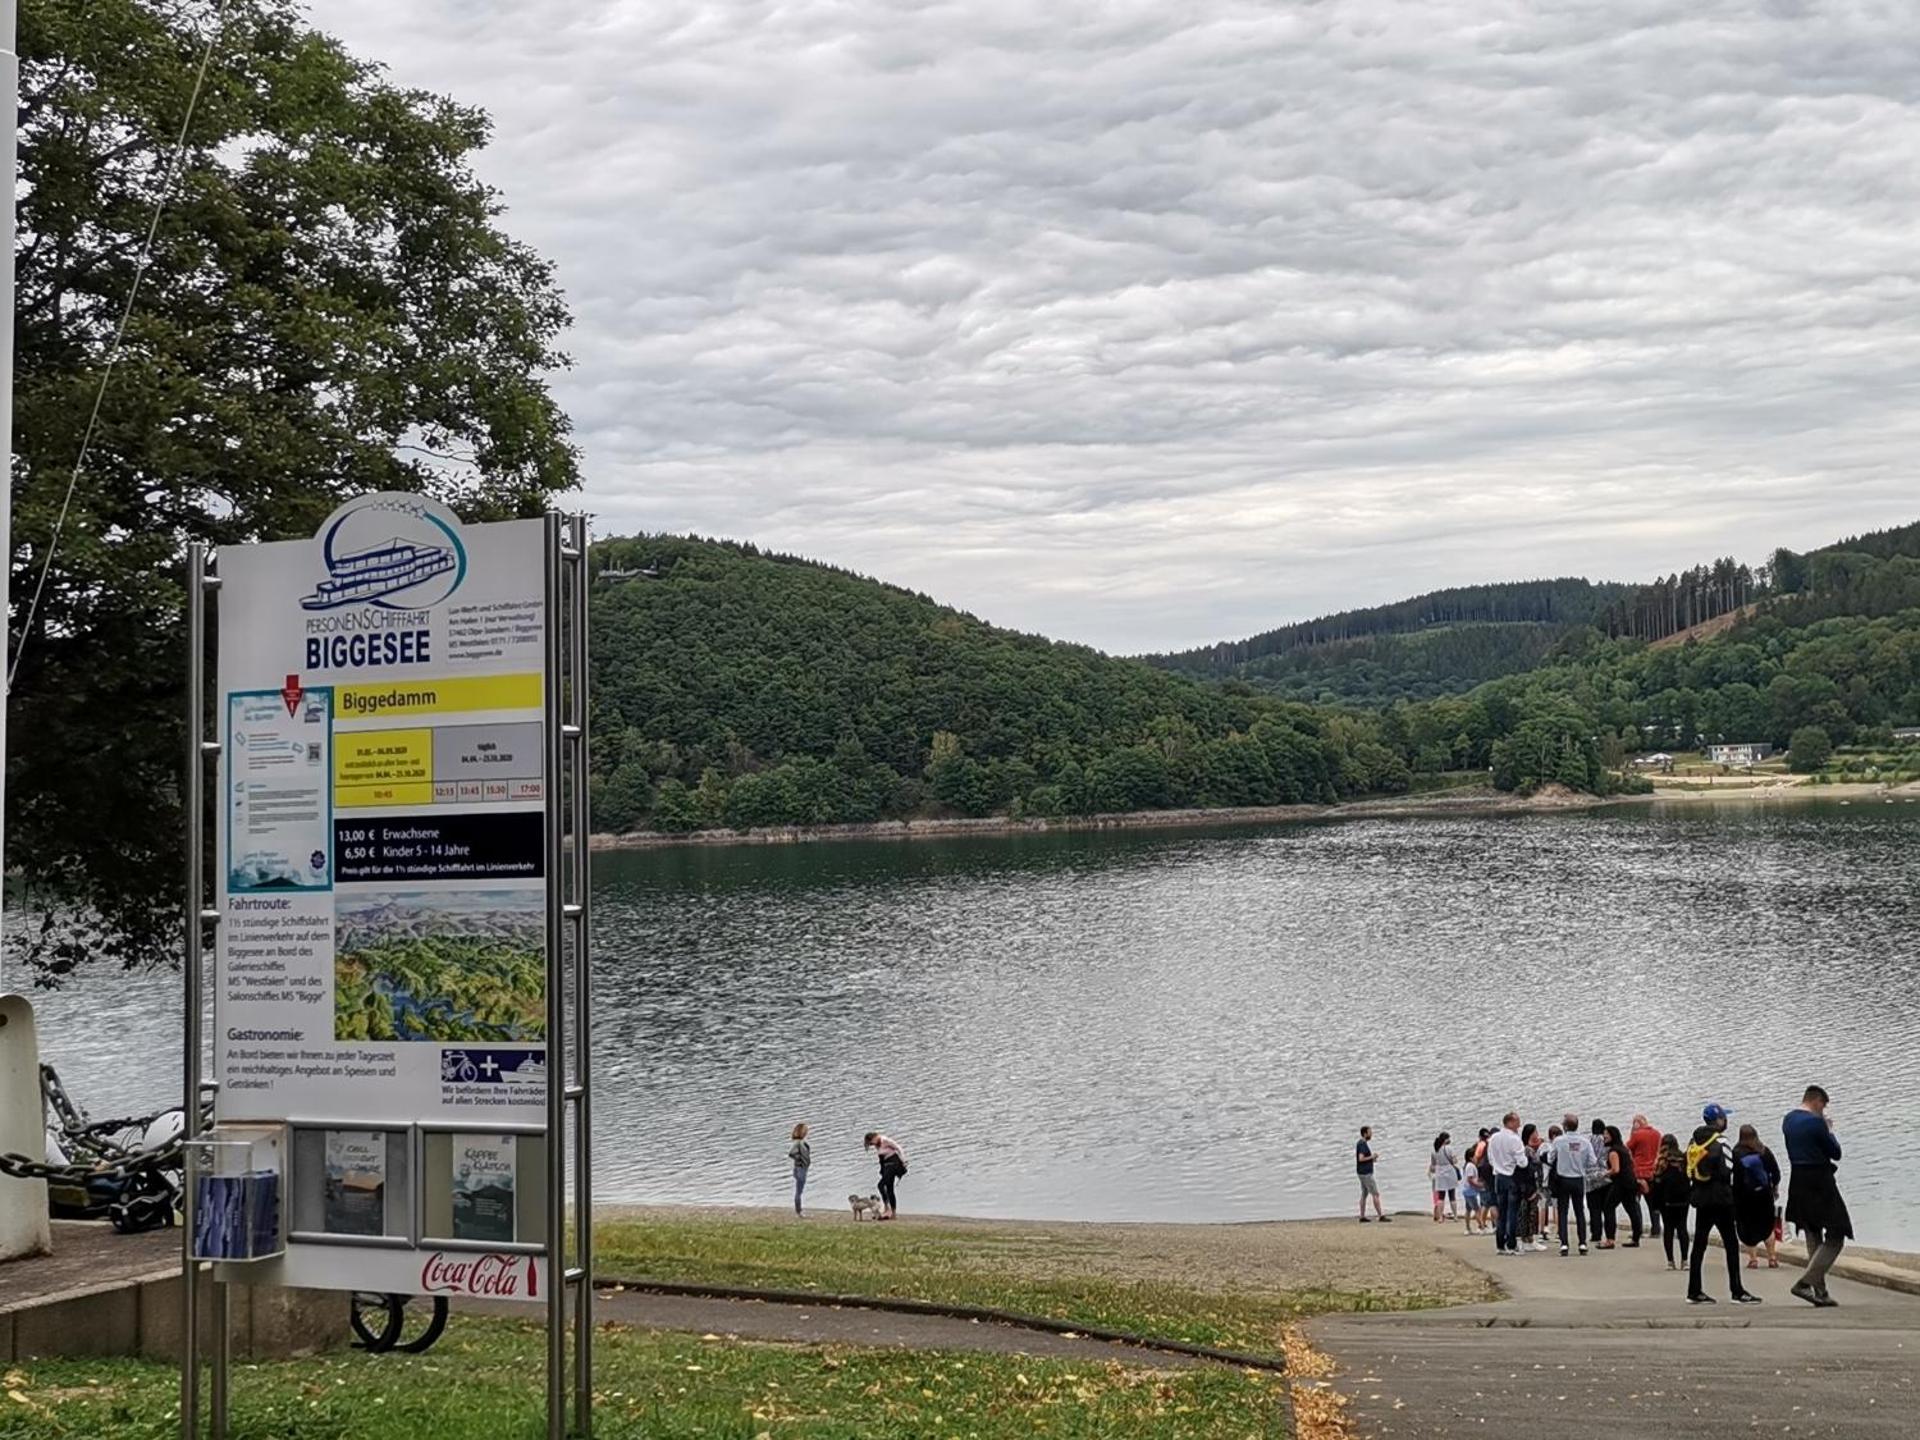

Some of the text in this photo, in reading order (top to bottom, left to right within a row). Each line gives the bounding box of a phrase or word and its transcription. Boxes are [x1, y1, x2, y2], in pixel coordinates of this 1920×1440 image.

[306, 629, 431, 669] BIGGESEE
[343, 689, 436, 713] Biggedamm
[339, 826, 440, 842] 13,00 € Erwachsene
[345, 847, 366, 860] 6,50
[368, 846, 376, 858] €
[383, 845, 414, 857] Kinder
[415, 844, 422, 856] 5
[431, 843, 442, 856] 14
[444, 843, 470, 856] Jahre
[486, 861, 535, 872] Linienverkehr
[228, 898, 292, 910] Fahrtroute:
[240, 931, 295, 942] Linienverkehr
[296, 931, 310, 942] auf
[311, 932, 330, 941] dem
[278, 947, 298, 956] Bord
[299, 947, 313, 956] des
[228, 976, 241, 986] MS
[289, 976, 307, 986] und
[308, 976, 322, 986] des
[281, 991, 295, 1001] MS
[227, 1027, 304, 1041] Gastronomie:
[227, 1050, 239, 1059] An
[240, 1050, 258, 1059] Bord
[260, 1050, 285, 1059] bieten
[301, 1050, 324, 1059] Ihnen
[325, 1052, 335, 1060] zu
[335, 1051, 357, 1063] jeder
[357, 1050, 394, 1063] Tageszeit
[227, 1065, 396, 1078] ein reichhaltiges Angebot an Speisen und
[422, 1252, 521, 1295] Coca-Cola
